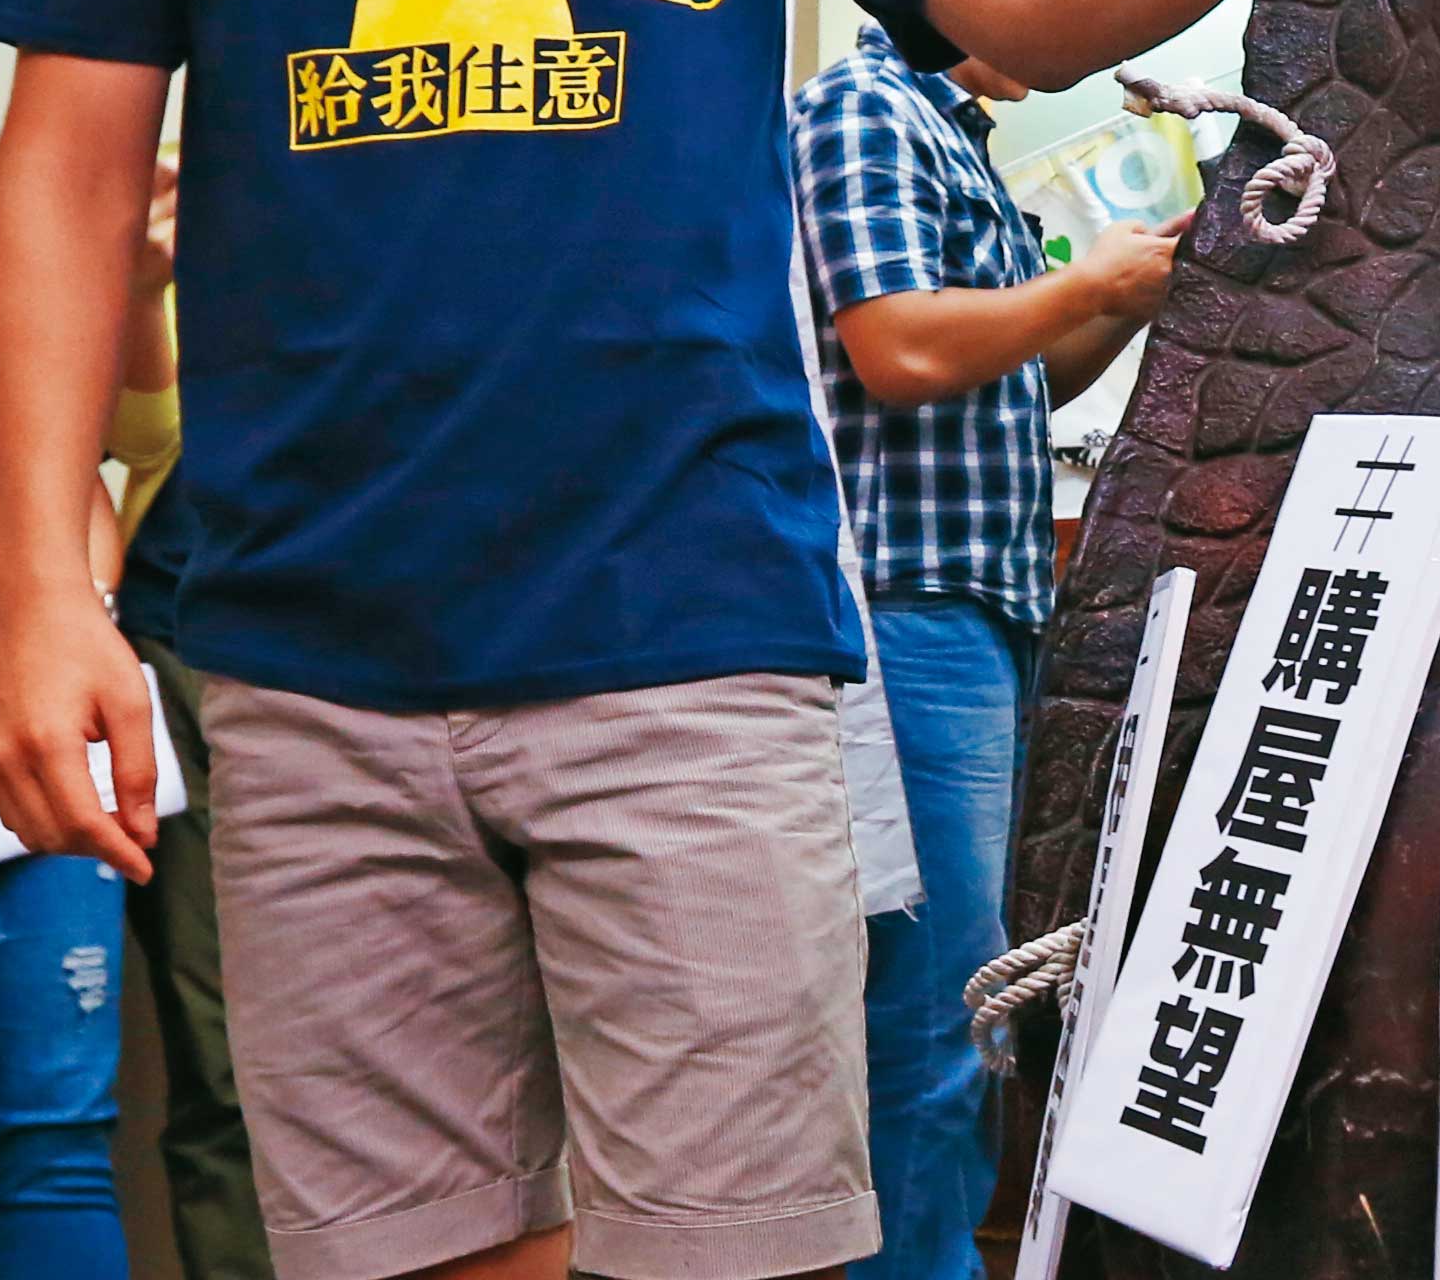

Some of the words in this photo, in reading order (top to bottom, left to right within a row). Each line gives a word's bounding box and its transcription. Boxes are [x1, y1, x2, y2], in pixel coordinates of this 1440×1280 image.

[297, 41, 616, 137] 給我住意
[1120, 434, 1416, 1156] #購屋無望
